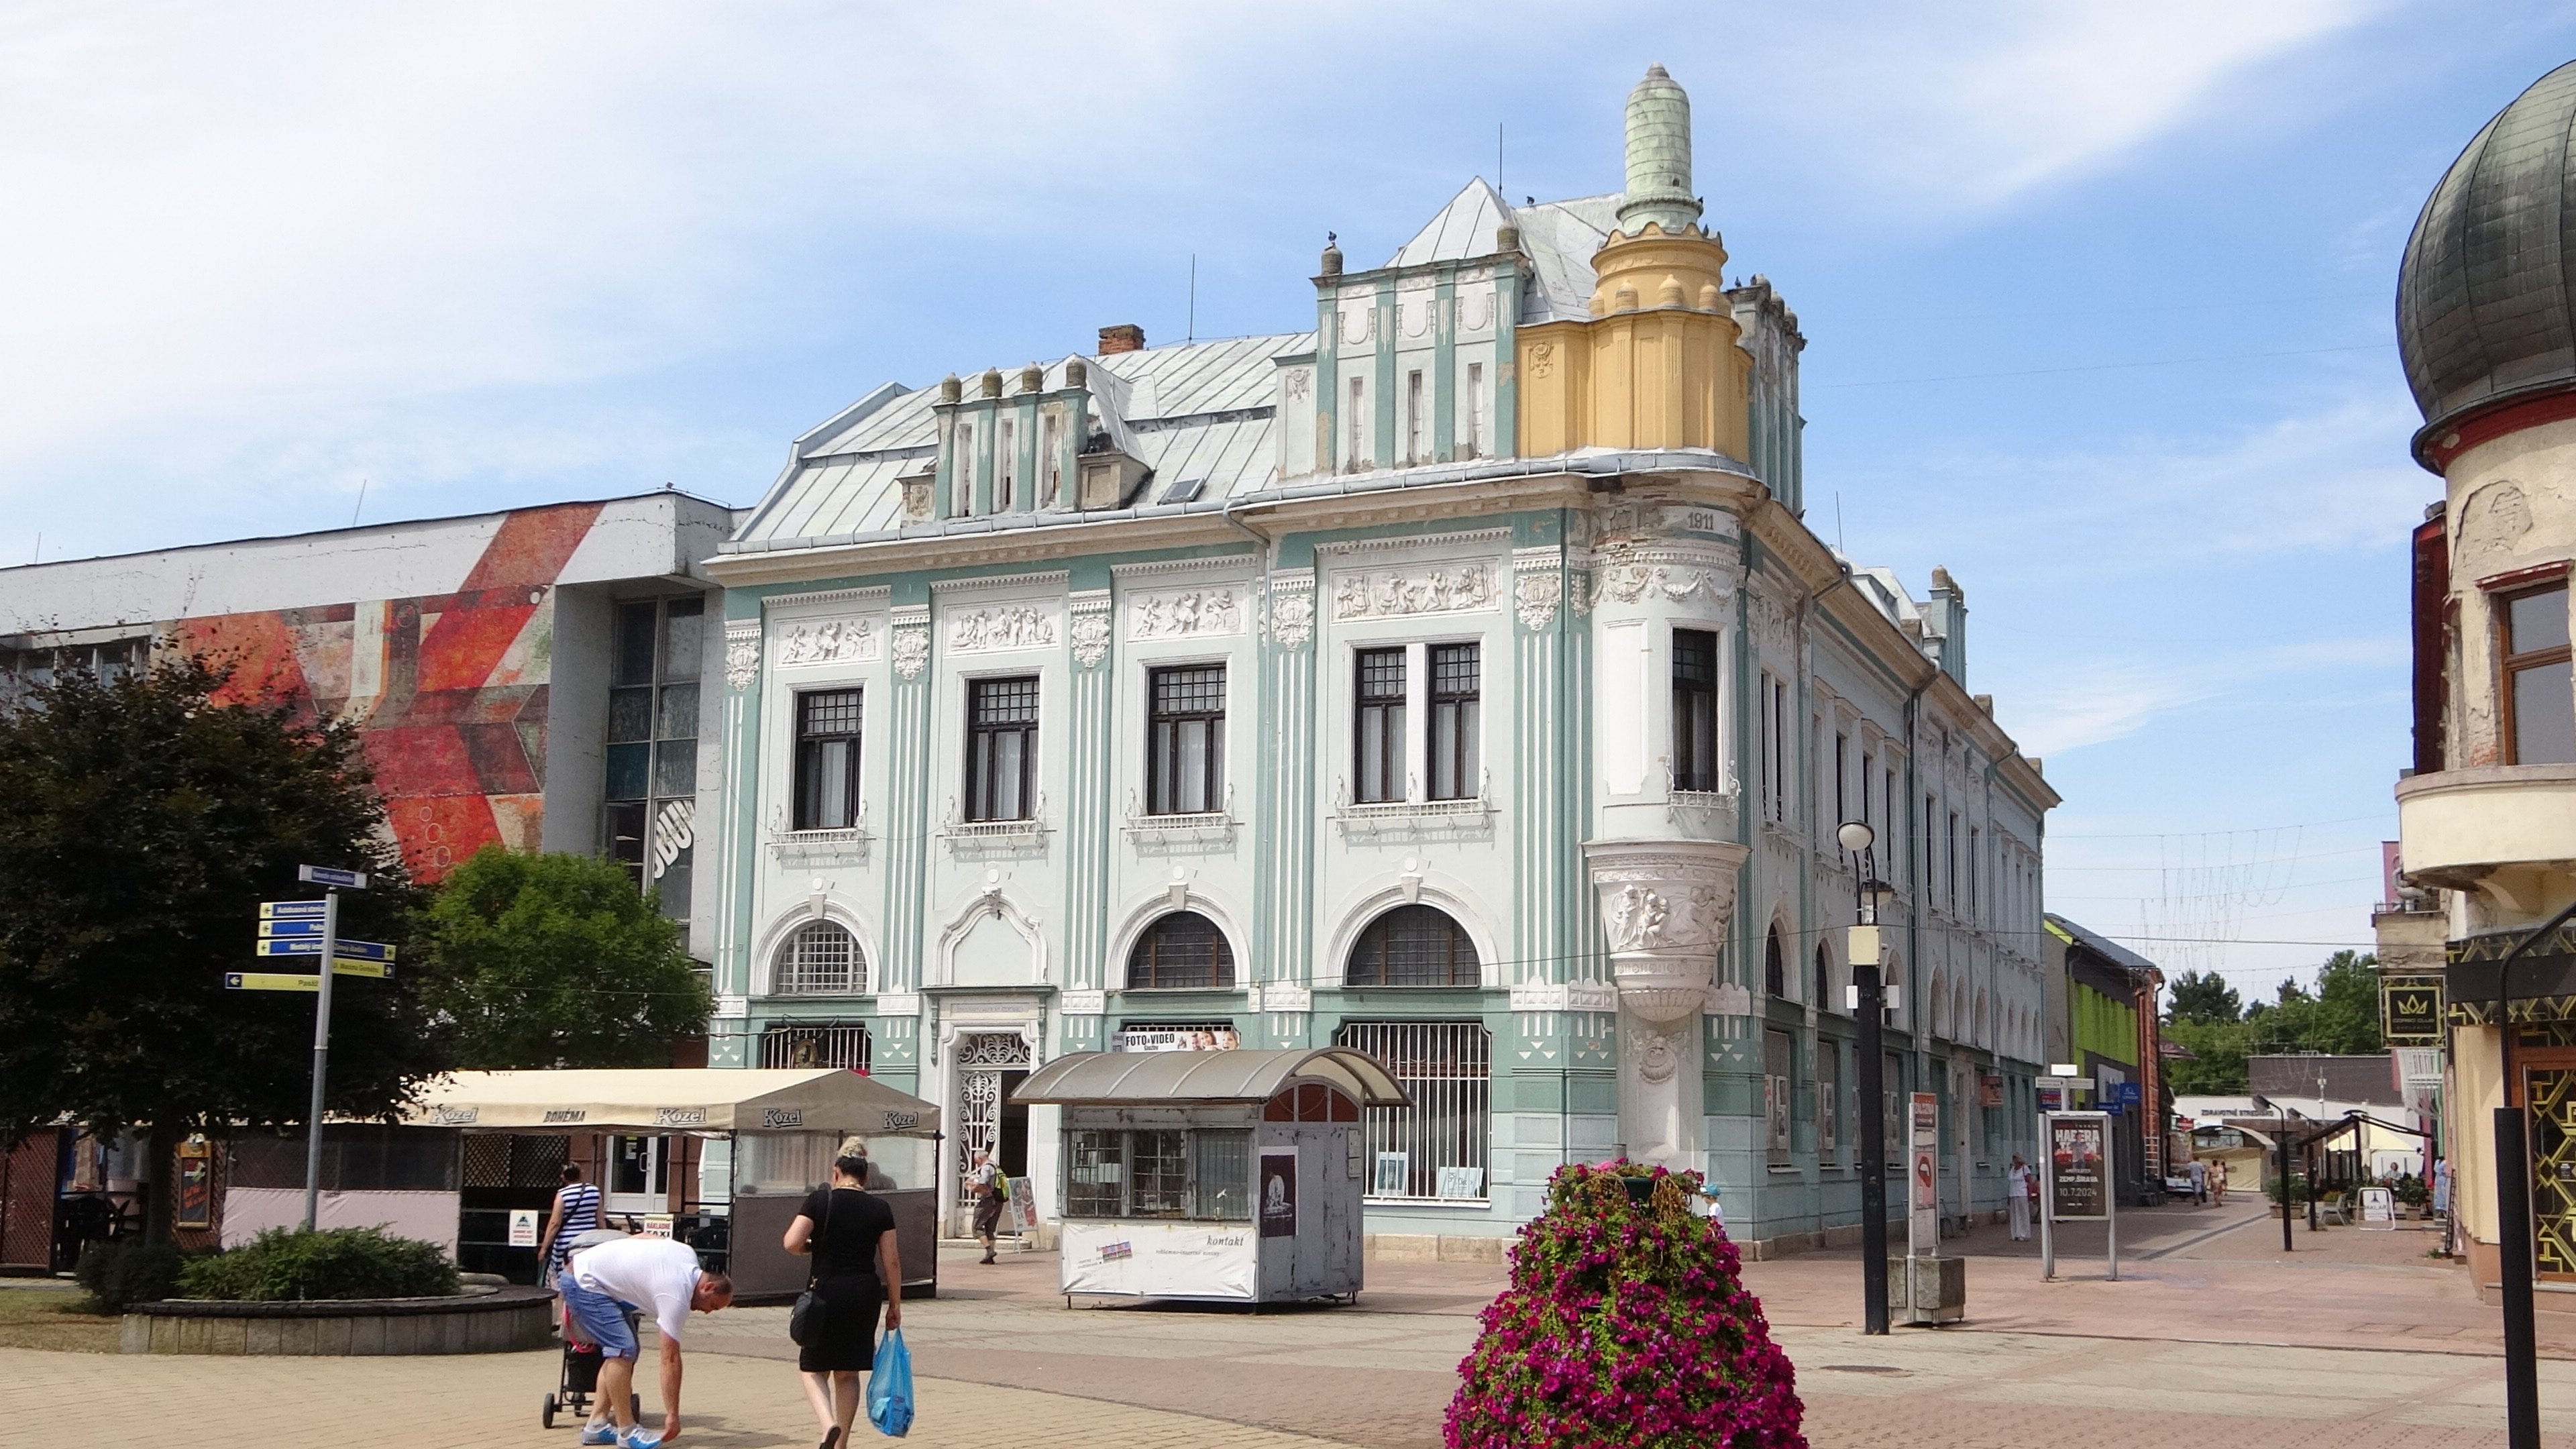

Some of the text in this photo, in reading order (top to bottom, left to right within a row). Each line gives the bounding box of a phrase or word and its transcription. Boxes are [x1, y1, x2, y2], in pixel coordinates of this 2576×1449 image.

[1688, 512, 1714, 530] 1911
[429, 1108, 479, 1124] Kozel
[543, 1108, 586, 1123] BOHÉMA
[653, 1108, 706, 1126] Kozel
[763, 1108, 802, 1128] Kozel
[883, 1112, 919, 1129] Kozel
[1207, 1235, 1244, 1246] kontakt
